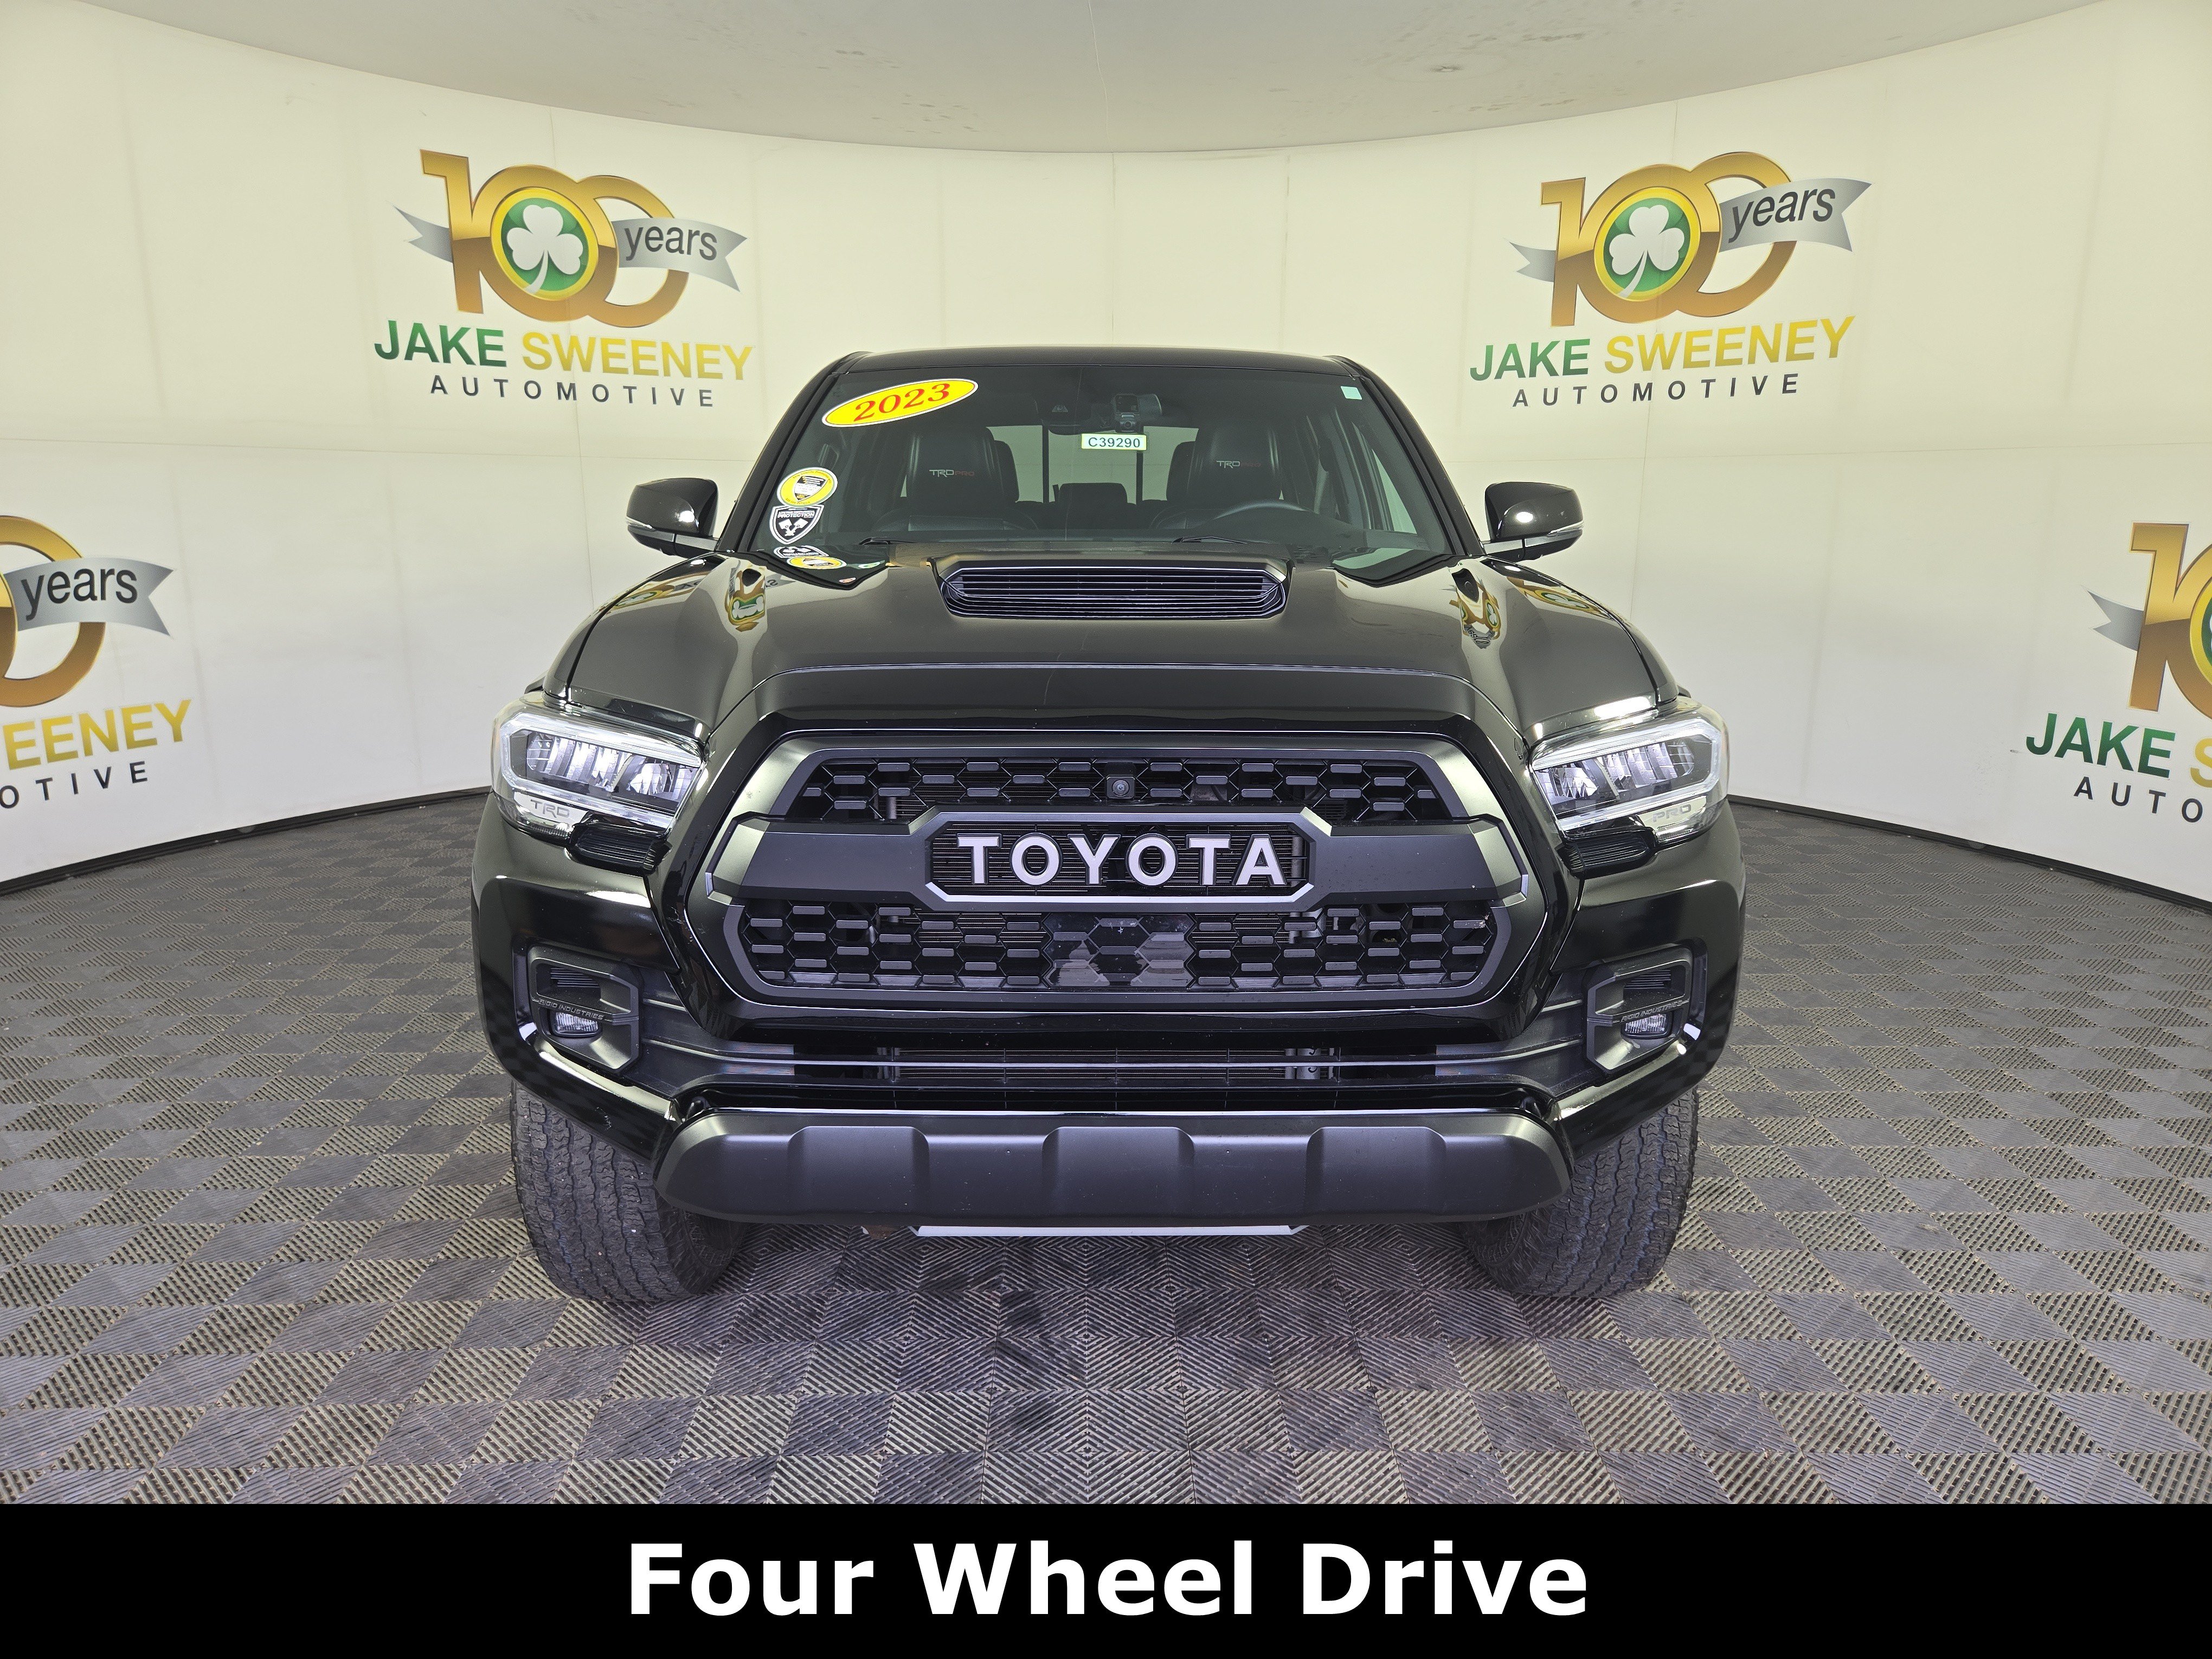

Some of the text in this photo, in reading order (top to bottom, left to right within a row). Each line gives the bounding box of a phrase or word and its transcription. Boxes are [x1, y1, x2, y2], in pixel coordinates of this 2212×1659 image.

[420, 149, 718, 328] 100 years
[1540, 151, 1836, 327] 100 years
[374, 319, 753, 381] JAKE SWEENEY
[1469, 315, 1856, 382] JAKE SWEENEY
[430, 375, 713, 408] AUTOMOTIVE
[853, 383, 950, 422] 2023
[1512, 372, 1799, 408] AUTOMOTIVE
[1088, 436, 1141, 448] C39290
[929, 469, 955, 478] TRD
[1216, 460, 1240, 468] TRD
[21, 568, 138, 622] years
[2025, 712, 2176, 779] JAKE
[530, 799, 570, 818] TRD
[1652, 803, 1692, 823] PRO
[955, 832, 1288, 887] TOYOTA
[538, 999, 605, 1020] RIGID INDUSTRIES
[1621, 1012, 1641, 1023] RIGID
